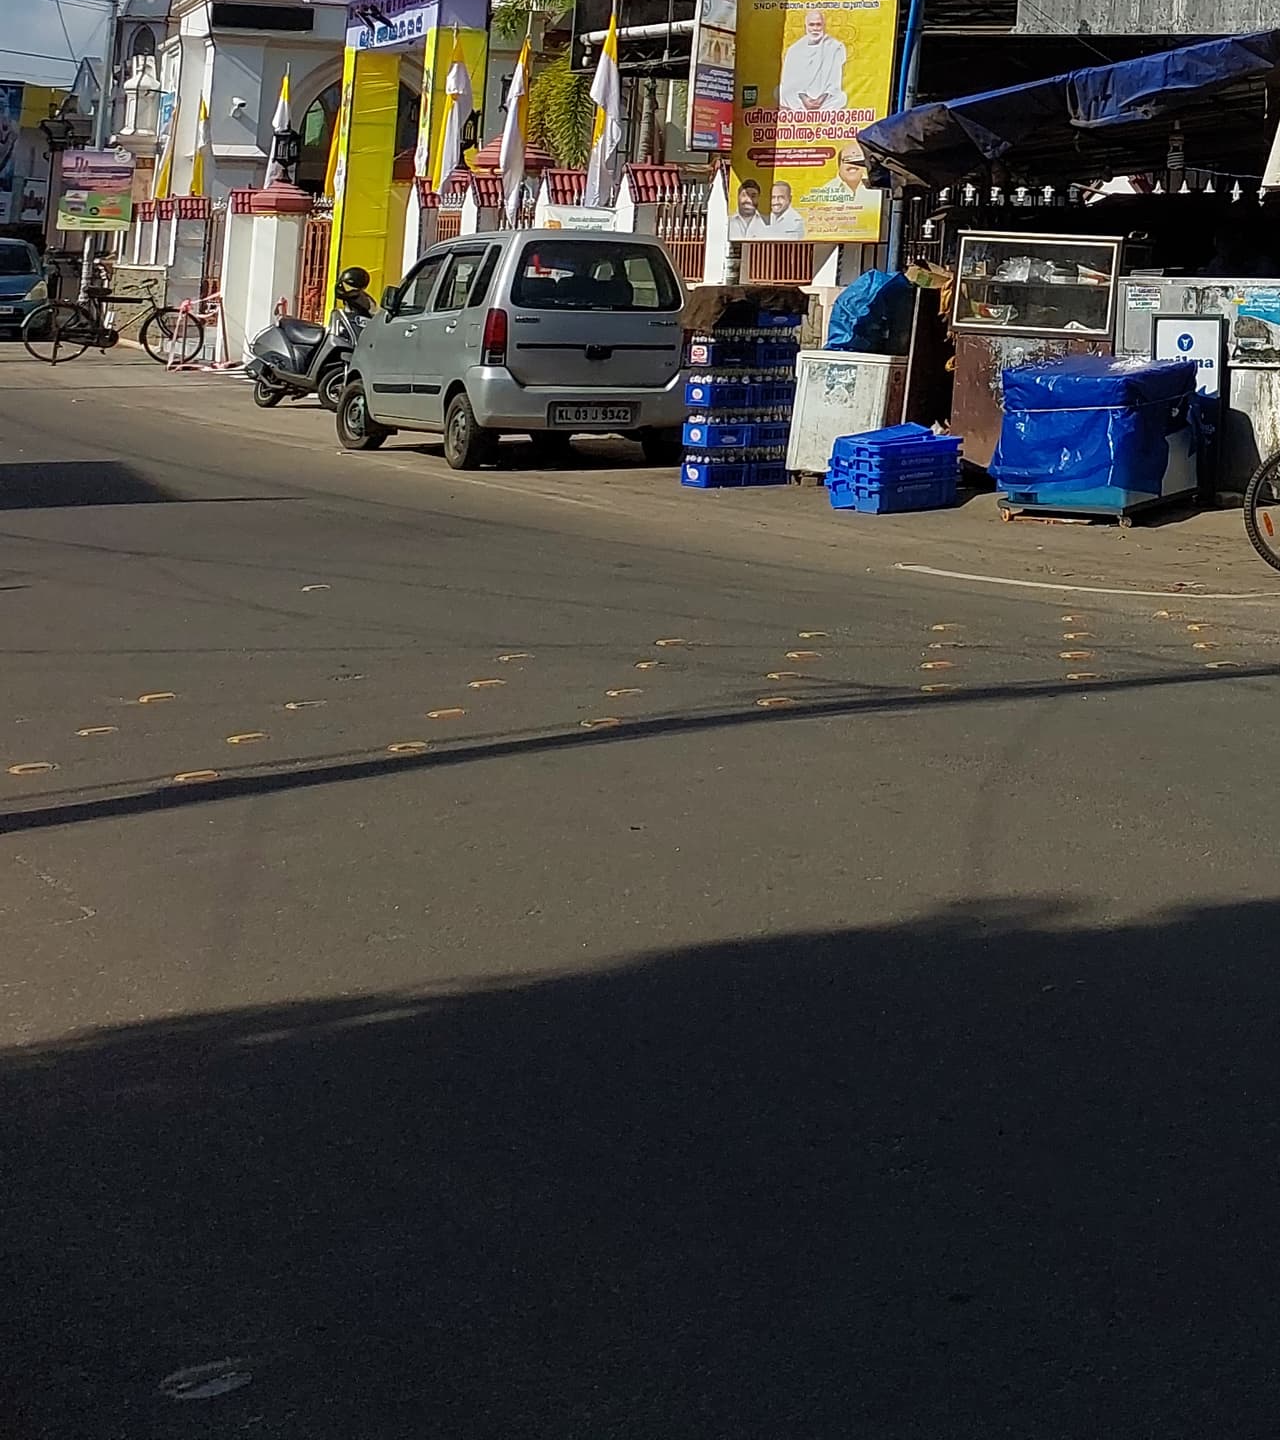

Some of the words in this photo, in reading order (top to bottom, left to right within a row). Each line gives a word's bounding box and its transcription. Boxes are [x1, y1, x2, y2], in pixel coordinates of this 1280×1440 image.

[754, 2, 777, 10] SNDP
[557, 409, 571, 421] KL
[574, 409, 588, 421] 03
[591, 409, 599, 421] J
[601, 409, 630, 421] 9342
